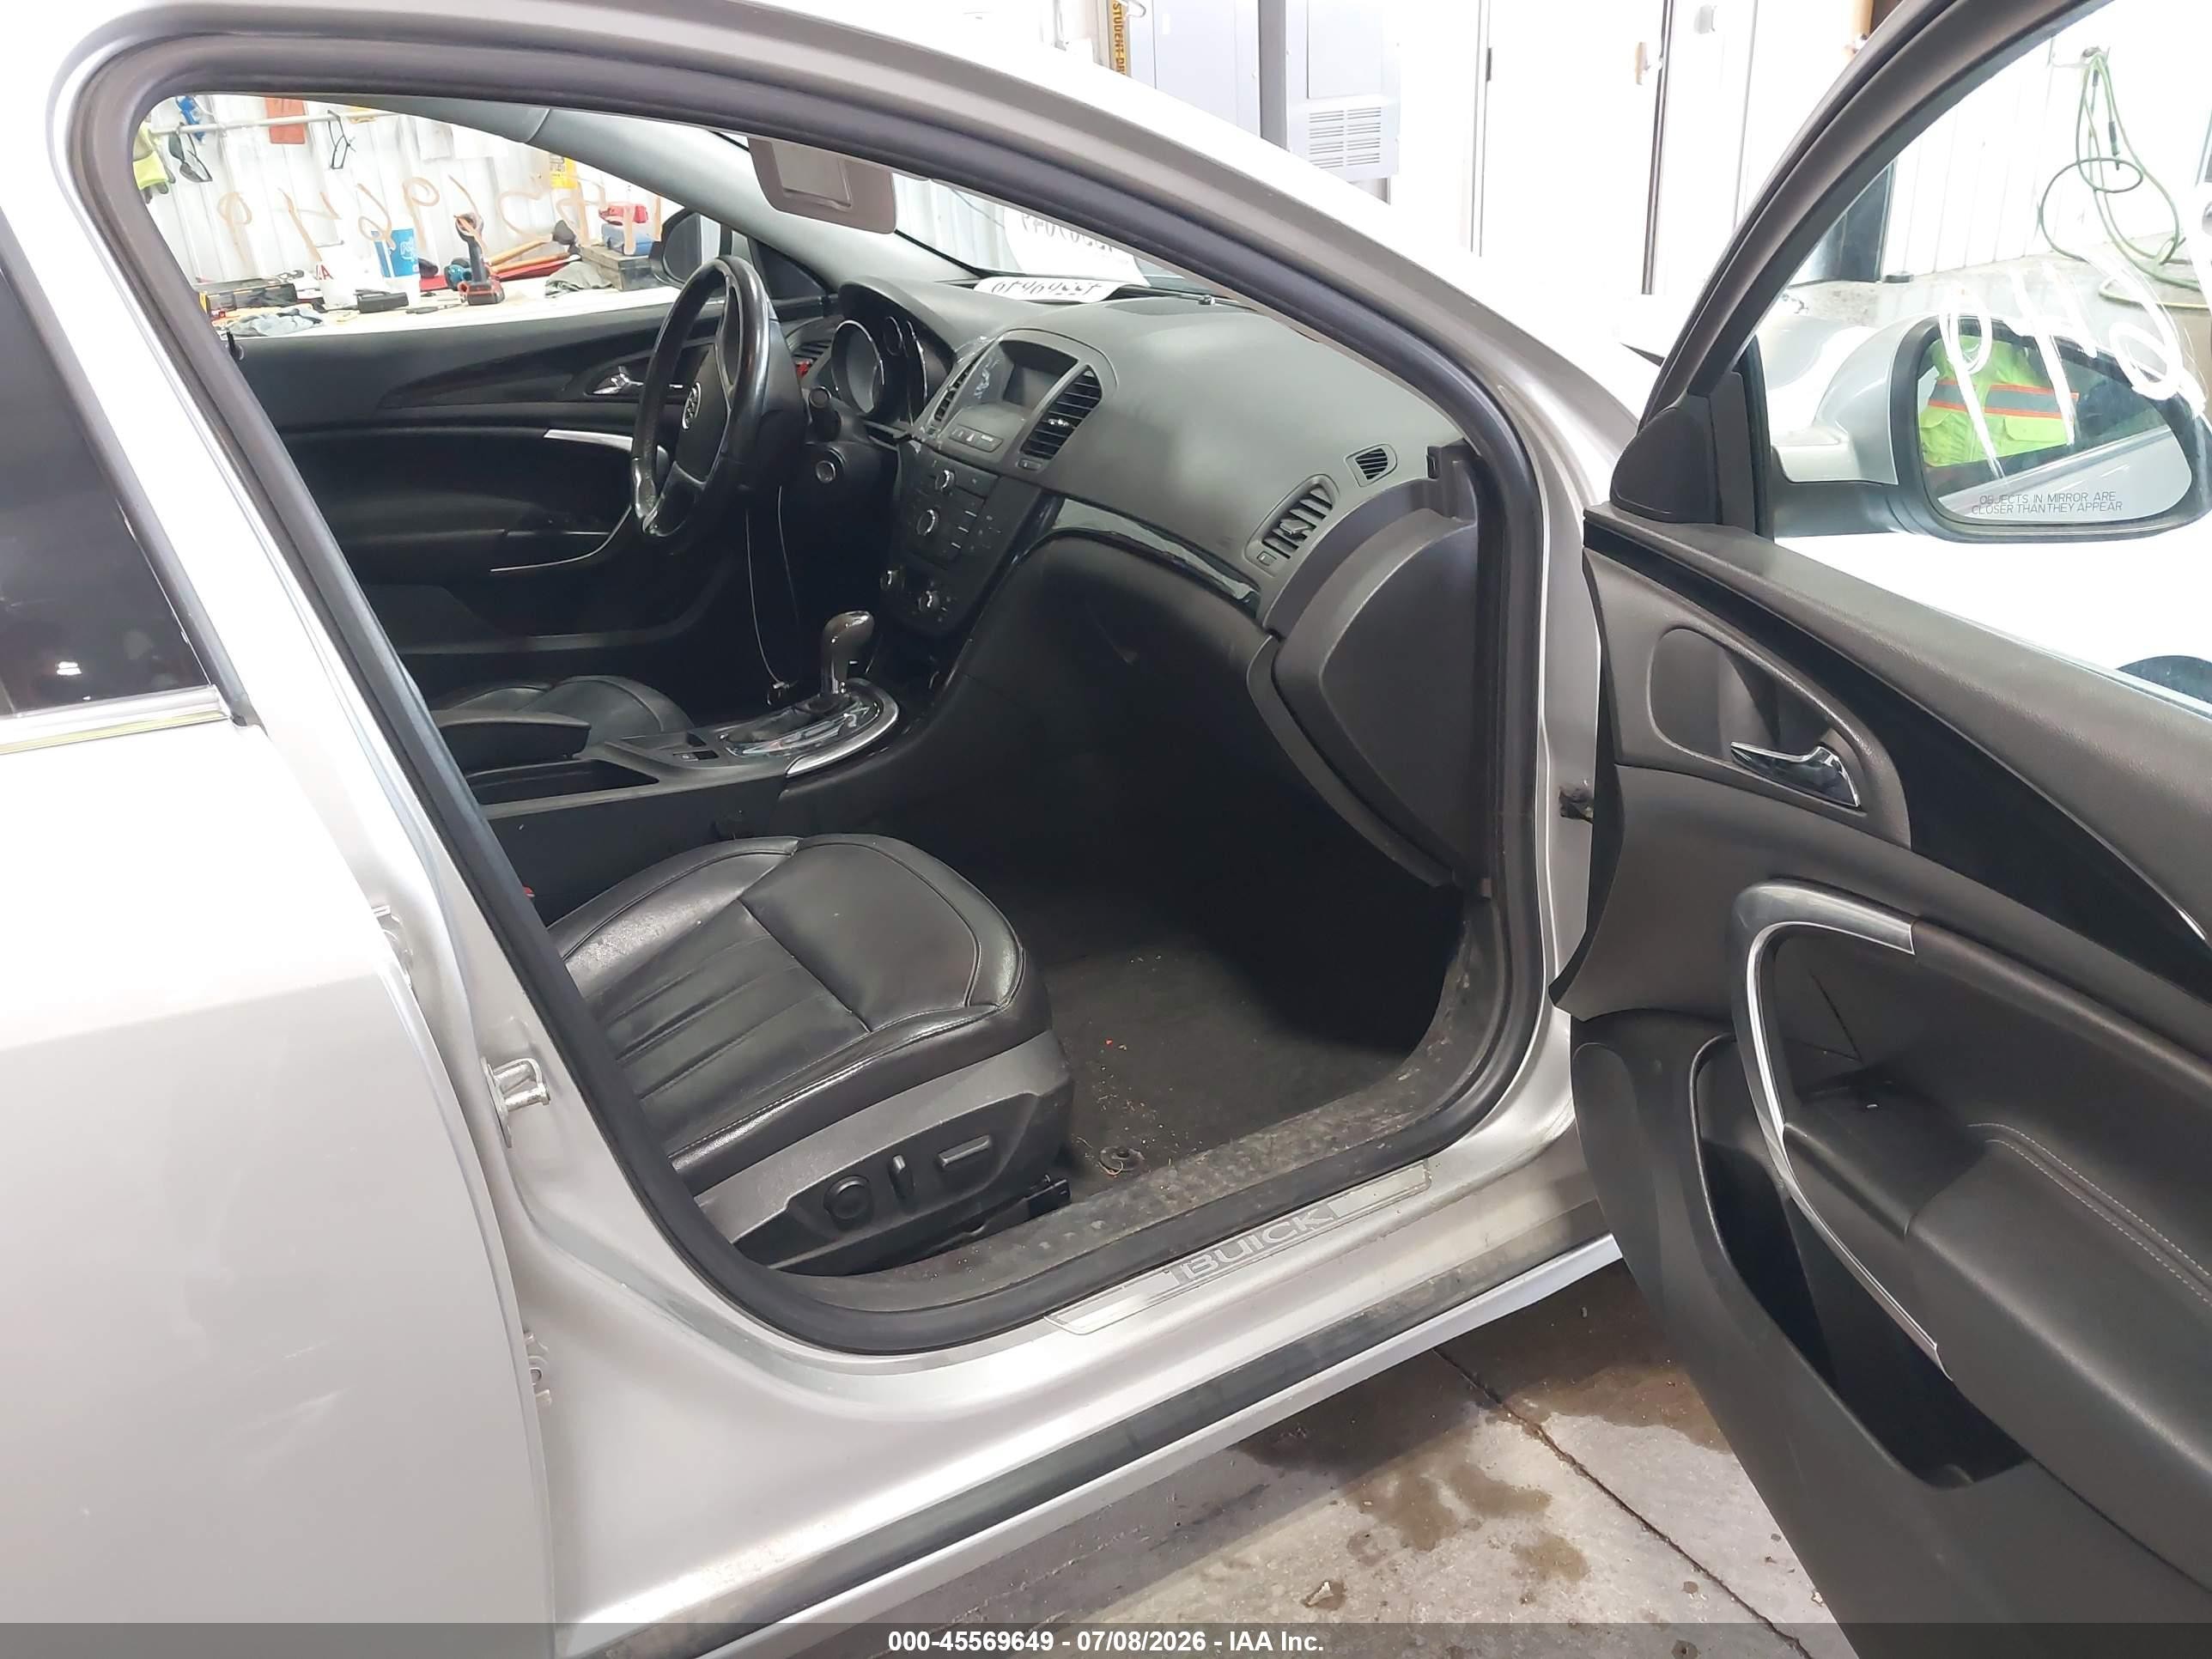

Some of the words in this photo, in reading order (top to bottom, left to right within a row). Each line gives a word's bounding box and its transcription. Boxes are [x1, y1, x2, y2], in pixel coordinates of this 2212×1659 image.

[1979, 494, 2028, 505] OBJECTS
[2033, 494, 2043, 503] IN
[2047, 492, 2088, 502] MIRROR
[2093, 491, 2116, 501] ARE
[1972, 504, 2013, 515] CLOSER
[2017, 503, 2047, 514] THAN
[2047, 502, 2074, 513] THEY
[2076, 501, 2123, 512] APPEAR
[1180, 1207, 1334, 1279] BUICK
